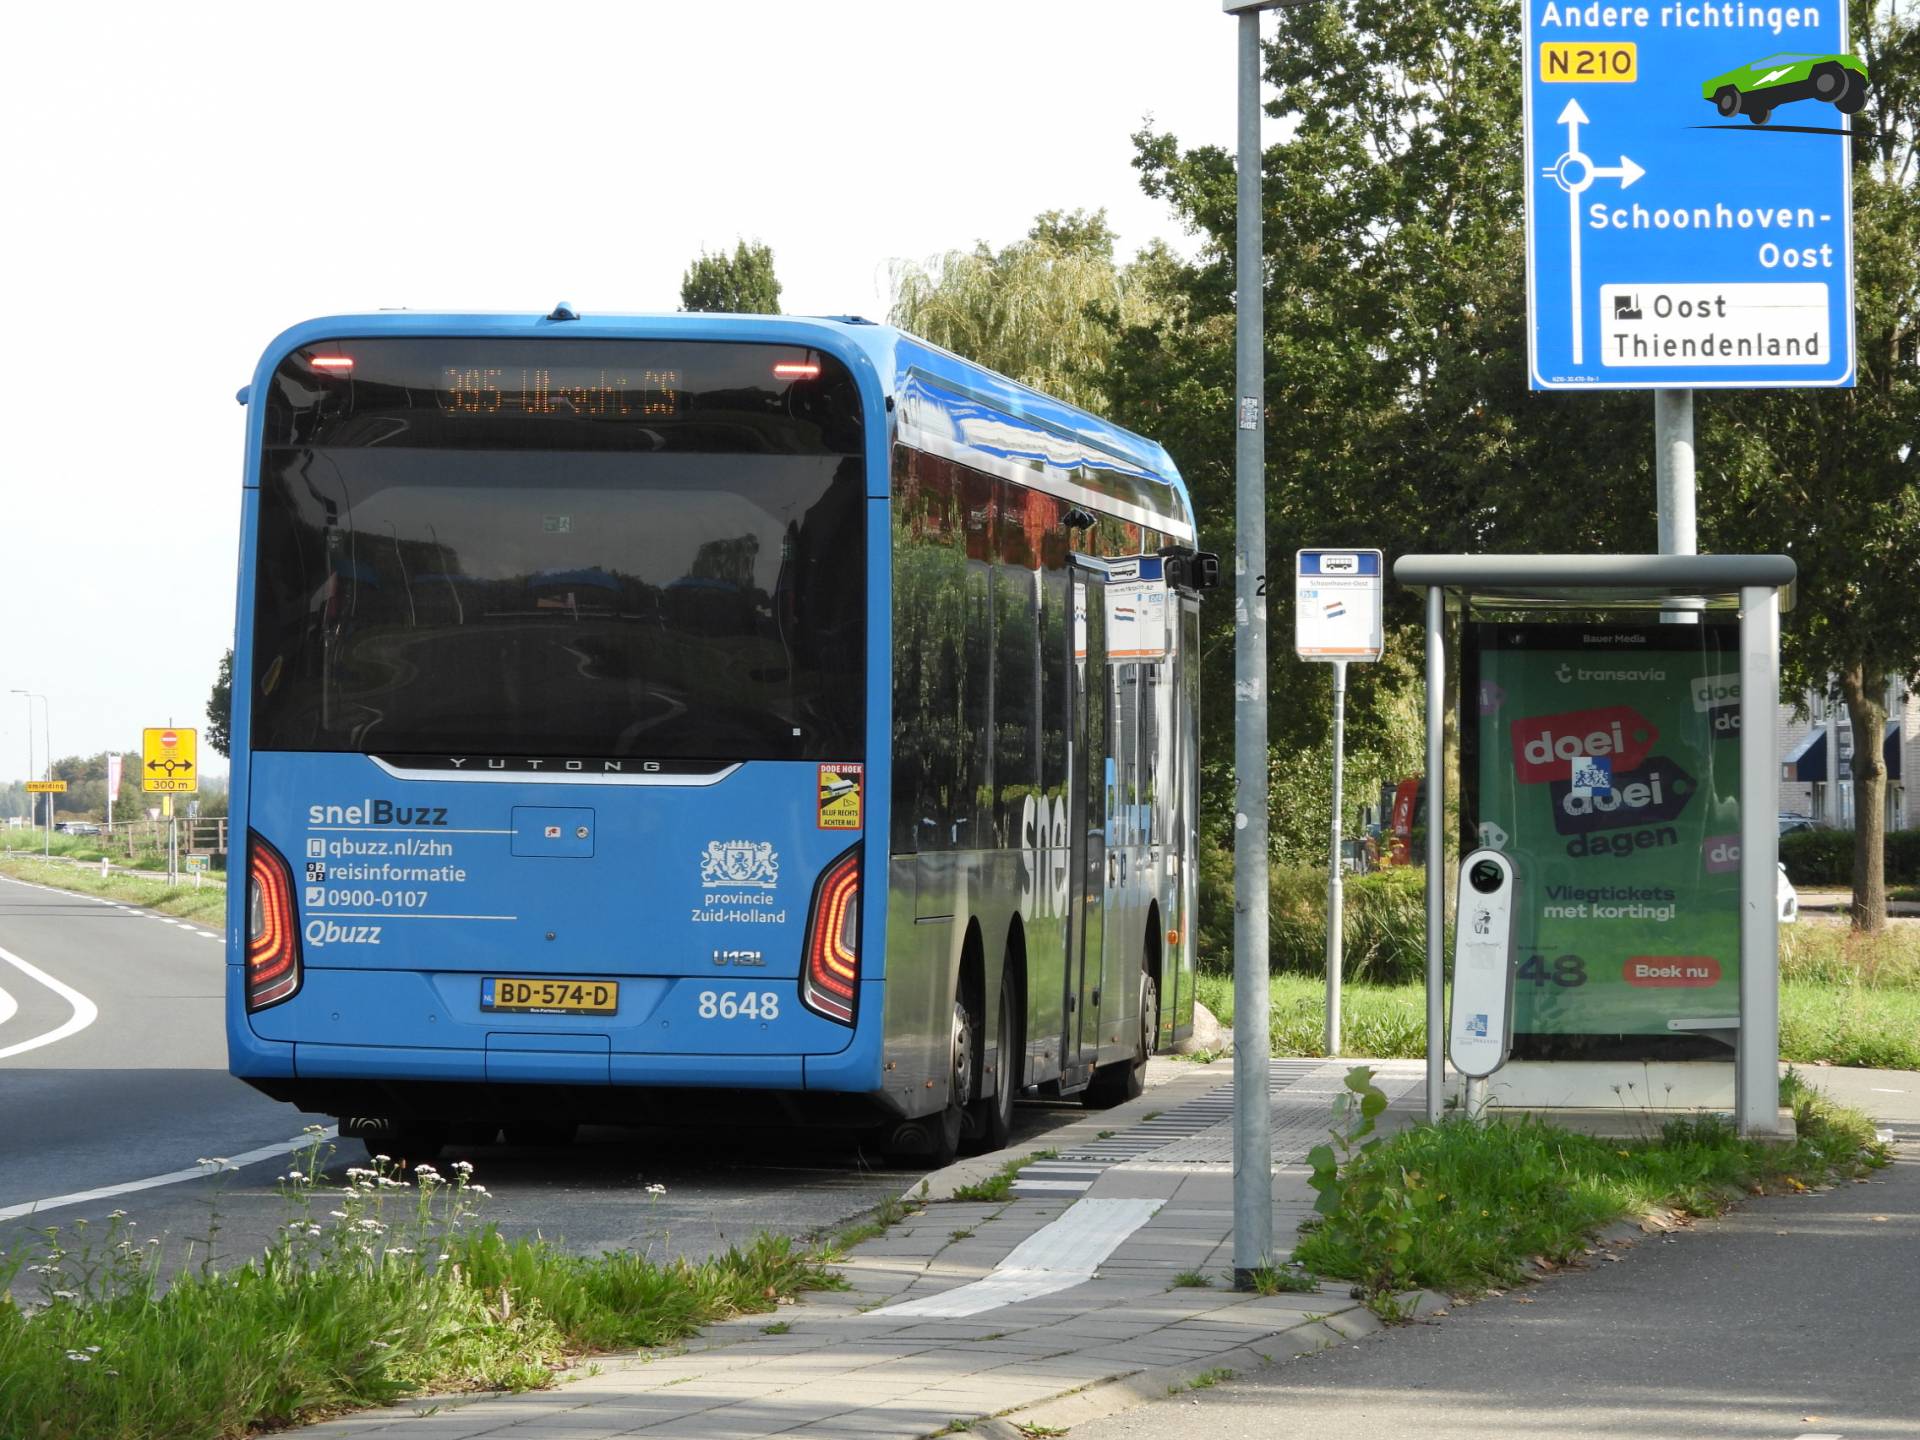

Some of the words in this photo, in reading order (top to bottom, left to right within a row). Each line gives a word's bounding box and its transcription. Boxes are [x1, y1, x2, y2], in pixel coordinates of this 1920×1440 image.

[1541, 2, 1649, 27] Andere
[1661, 2, 1820, 34] richtingen
[1589, 203, 1831, 229] Schoonhoven-
[1759, 243, 1832, 268] Oost
[1654, 294, 1726, 318] Oost
[1613, 332, 1819, 357] Thiendenland
[1583, 634, 1613, 643] Bauer
[1615, 634, 1646, 643] Media
[1577, 667, 1666, 681] transavia
[1698, 683, 1741, 702] doe
[1524, 721, 1624, 765] doei
[450, 758, 660, 772] YUTONG
[821, 765, 840, 773] DODE
[842, 765, 862, 773] HOEK
[153, 781, 175, 789] 300
[309, 799, 448, 826] snelBuzz
[329, 838, 453, 857] qbuzz.nl/zhn
[1566, 826, 1678, 859] dagen
[329, 864, 466, 882] reisinformatie
[328, 889, 428, 907] 0900-0107
[705, 891, 774, 907] provincie
[1546, 885, 1675, 903] Vliegtickets
[691, 908, 785, 923] Zuid-Holland
[1544, 904, 1587, 918] met
[1593, 903, 1675, 921] korting!
[305, 920, 382, 947] Qbuzz
[1635, 965, 1680, 978] Boek
[1685, 967, 1708, 978] nu
[483, 994, 493, 1002] NL
[501, 983, 608, 1006] BD-574-D
[699, 991, 779, 1020] 8648
